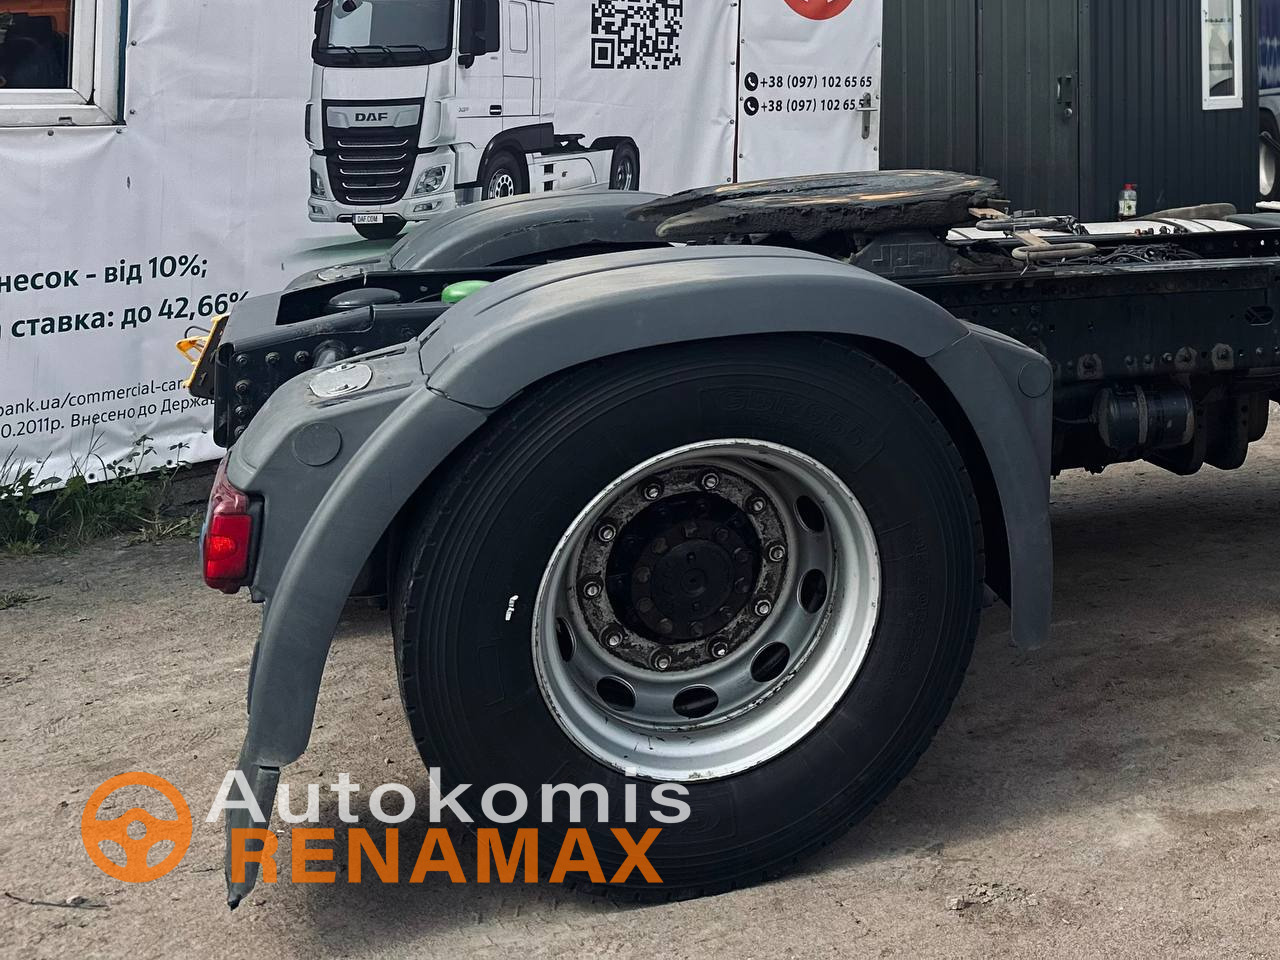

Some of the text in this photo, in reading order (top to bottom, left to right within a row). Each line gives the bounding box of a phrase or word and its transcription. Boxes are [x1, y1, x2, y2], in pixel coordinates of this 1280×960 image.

[760, 74, 873, 89] +38 (097) 102 65 65
[761, 99, 783, 112] +38
[786, 97, 817, 112] (097)
[820, 99, 840, 111] 102
[843, 98, 857, 111] 65
[354, 112, 389, 122] DAF
[0, 269, 79, 293] несок
[104, 259, 142, 286] від
[148, 253, 208, 280] 10%;
[11, 310, 114, 338] ставка:
[120, 305, 152, 330] до
[71, 407, 136, 428] Внесено
[137, 403, 157, 419] до
